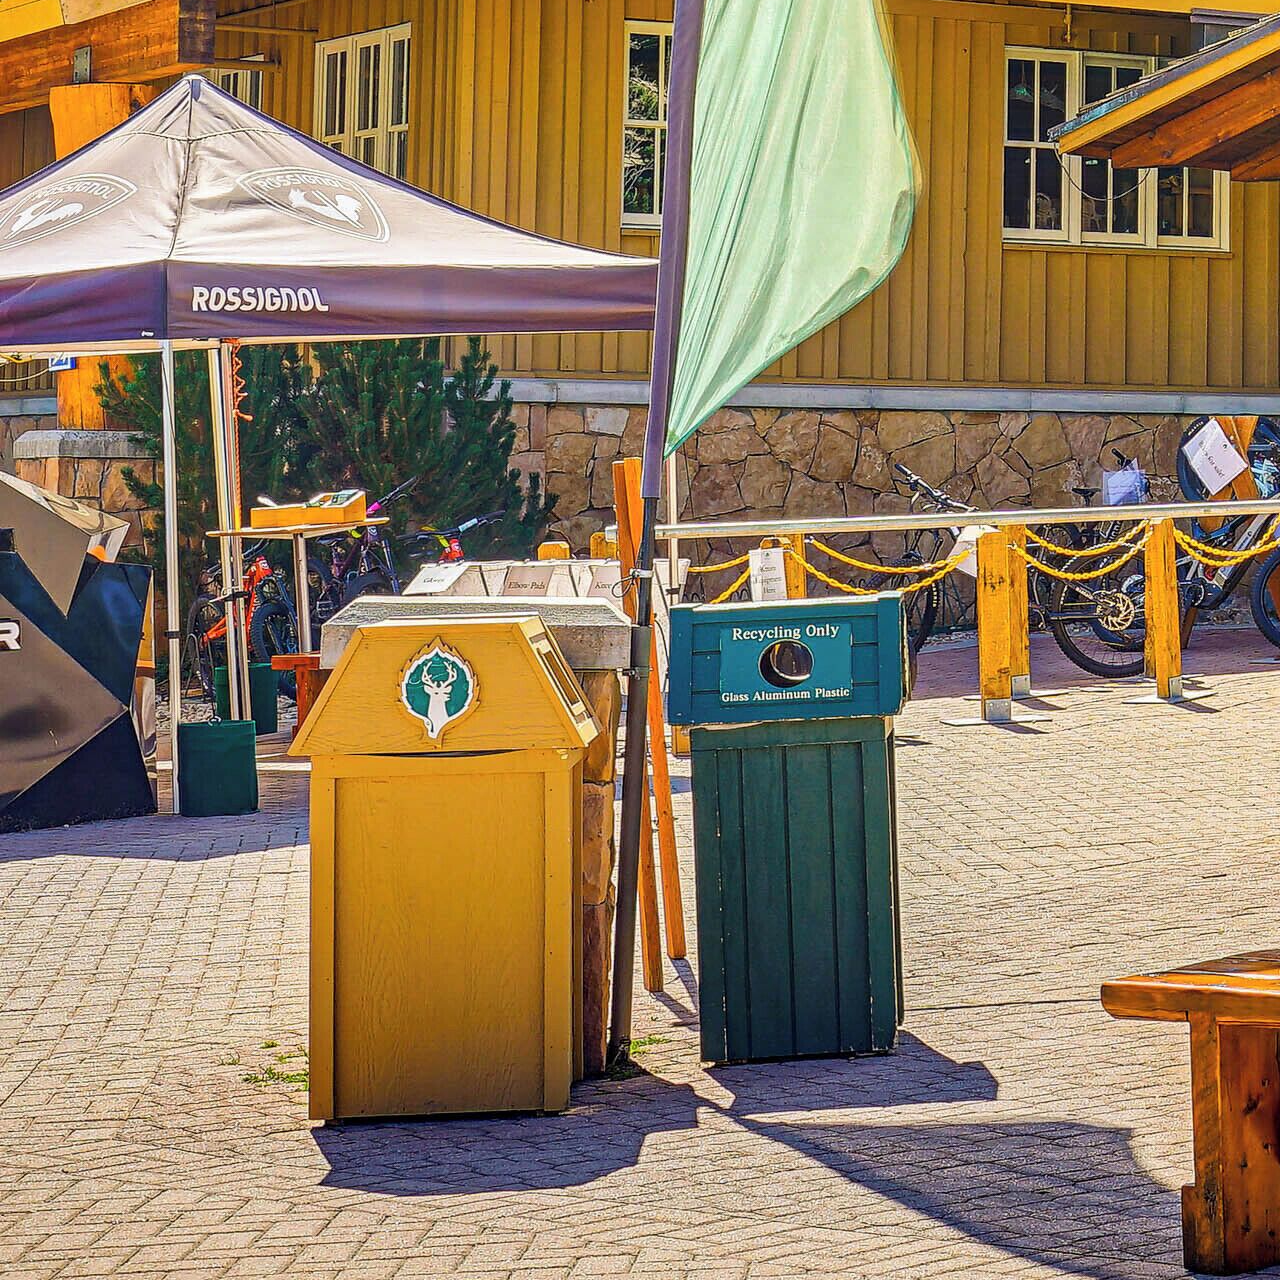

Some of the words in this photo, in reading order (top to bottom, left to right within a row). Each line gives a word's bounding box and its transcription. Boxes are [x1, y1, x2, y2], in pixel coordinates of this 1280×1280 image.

[192, 285, 329, 312] ROSSIGNOL
[732, 625, 801, 641] Recycling
[805, 624, 840, 638] Only
[721, 692, 749, 702] Glass
[752, 690, 811, 701] Aluminum
[815, 687, 850, 698] Plastic
